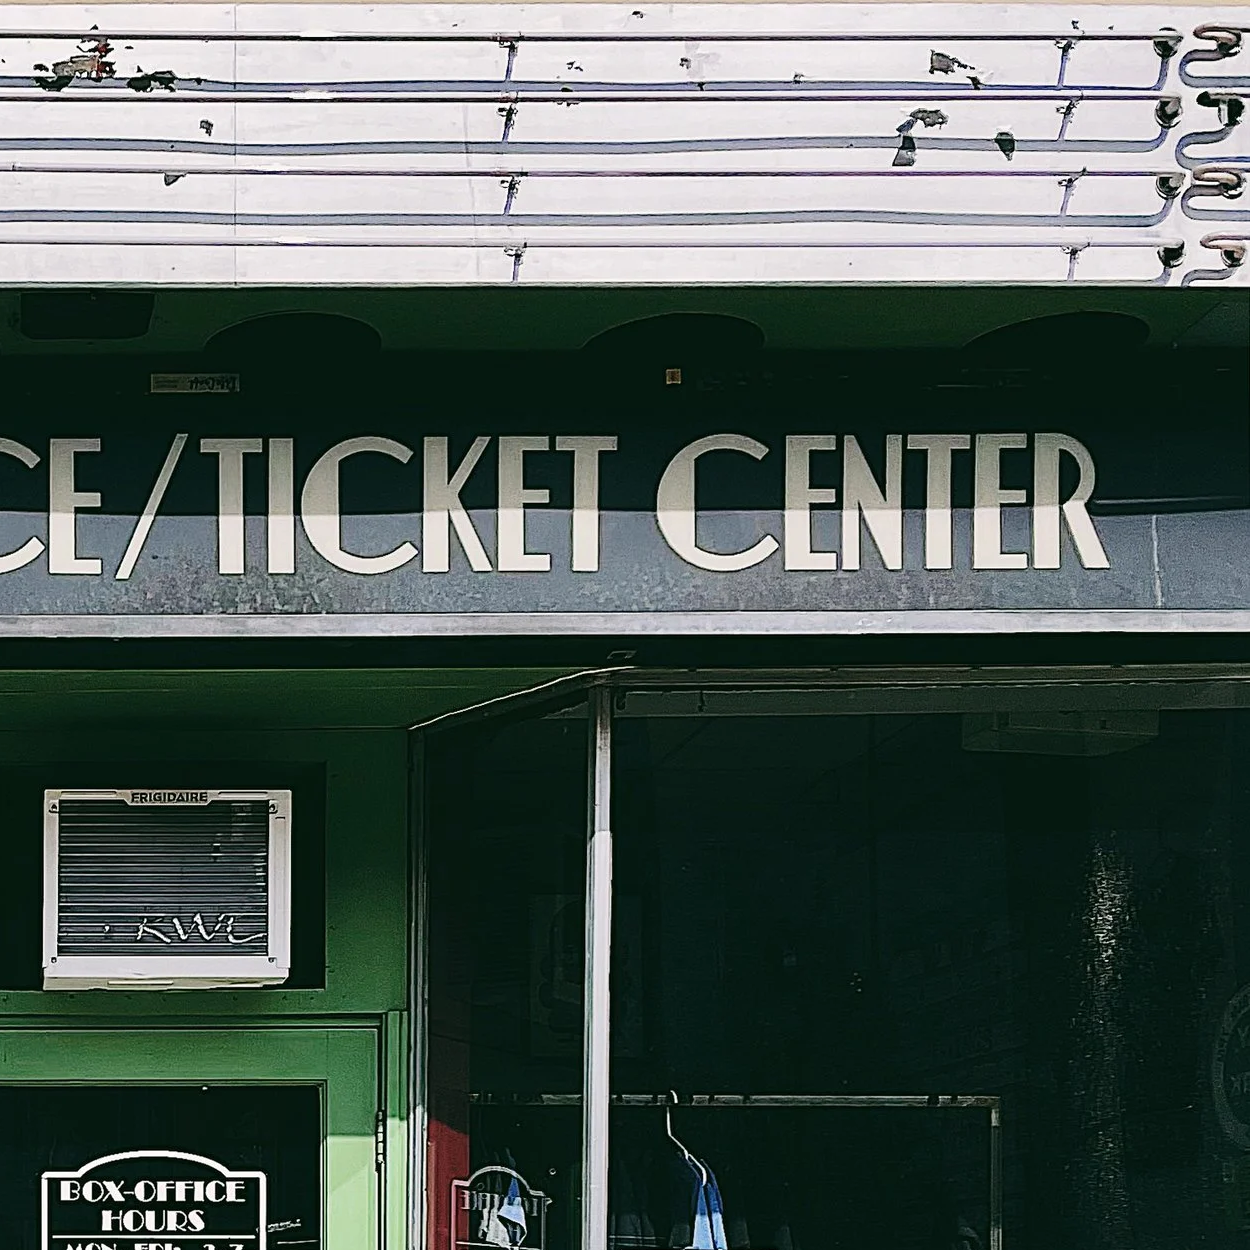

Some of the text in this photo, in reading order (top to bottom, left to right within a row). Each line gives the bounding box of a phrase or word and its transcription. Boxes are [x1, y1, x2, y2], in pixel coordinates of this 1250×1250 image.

[656, 432, 1111, 573] CENTER
[131, 792, 208, 803] FRIGIDAIRE
[59, 1180, 246, 1203] BOX-OFFICE
[100, 1209, 206, 1232] HOURS
